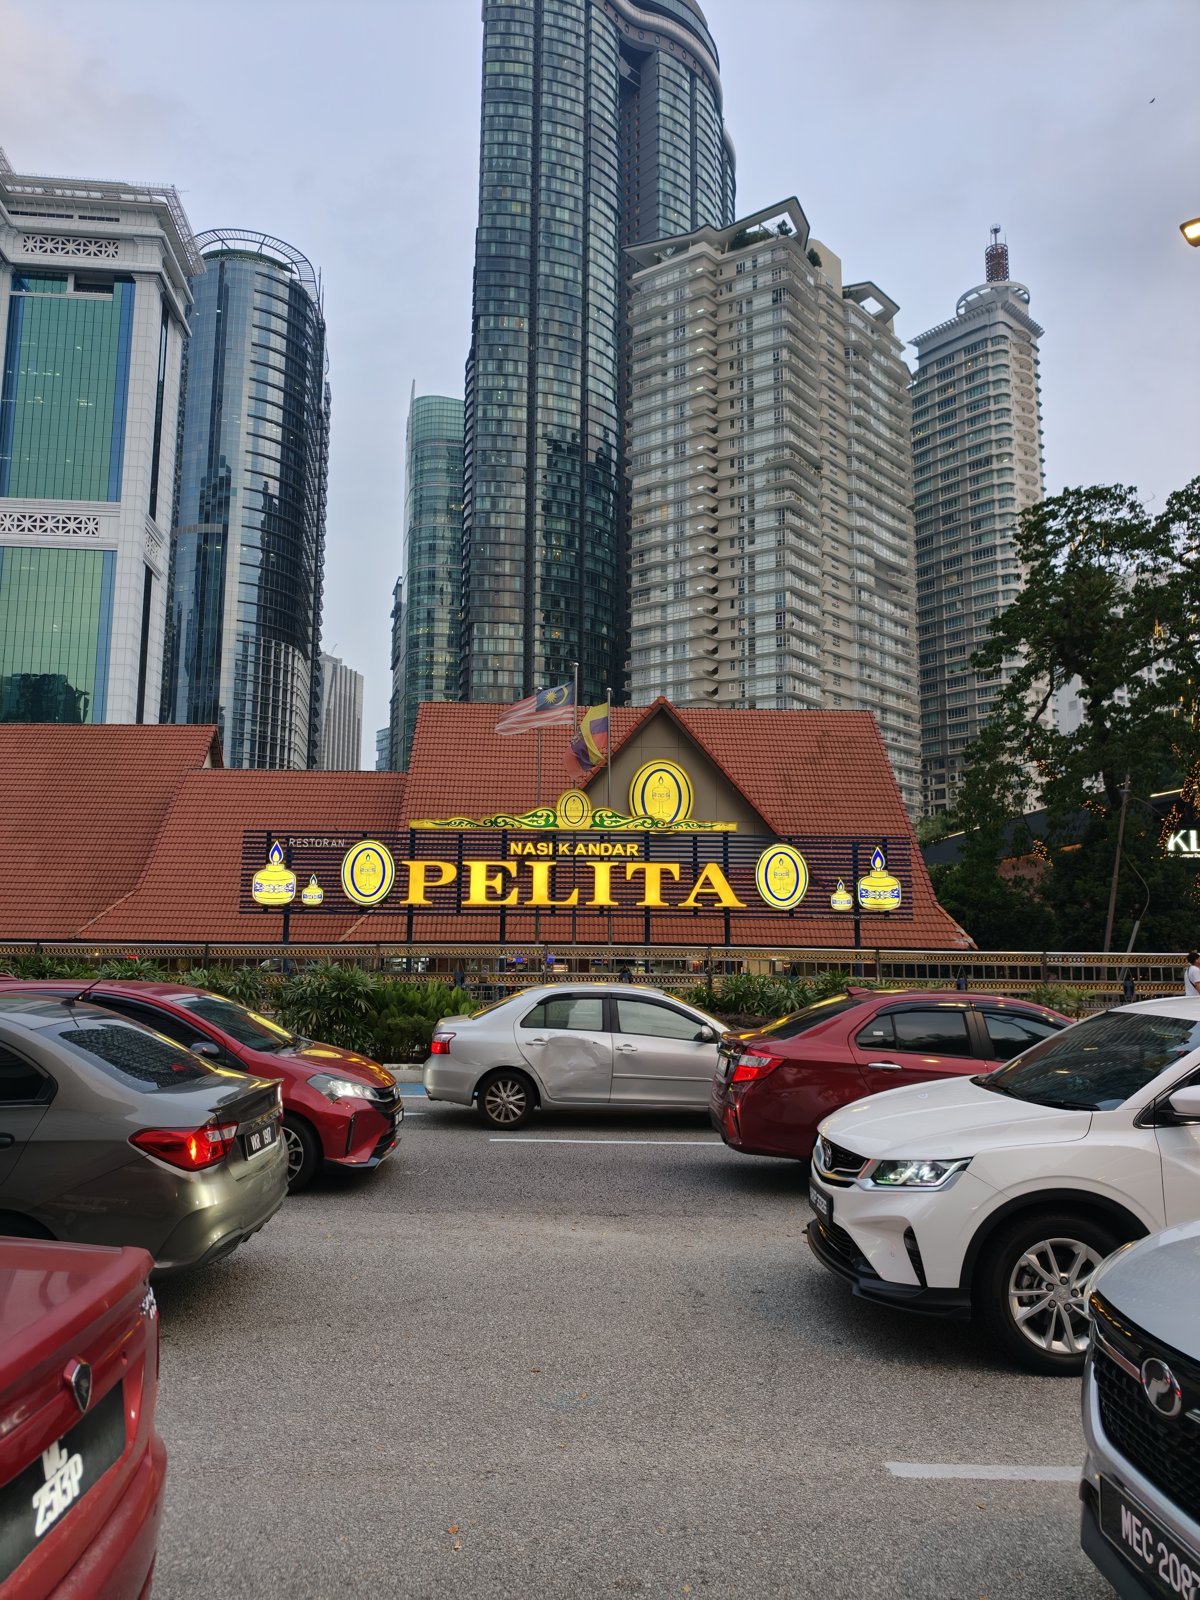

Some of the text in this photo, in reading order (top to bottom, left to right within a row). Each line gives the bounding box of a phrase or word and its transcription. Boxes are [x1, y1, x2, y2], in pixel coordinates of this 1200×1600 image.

[288, 837, 346, 849] RESTORAN
[510, 842, 639, 857] NASI KANDAR
[400, 860, 748, 908] PELITA
[1121, 1504, 1154, 1565] MEC
